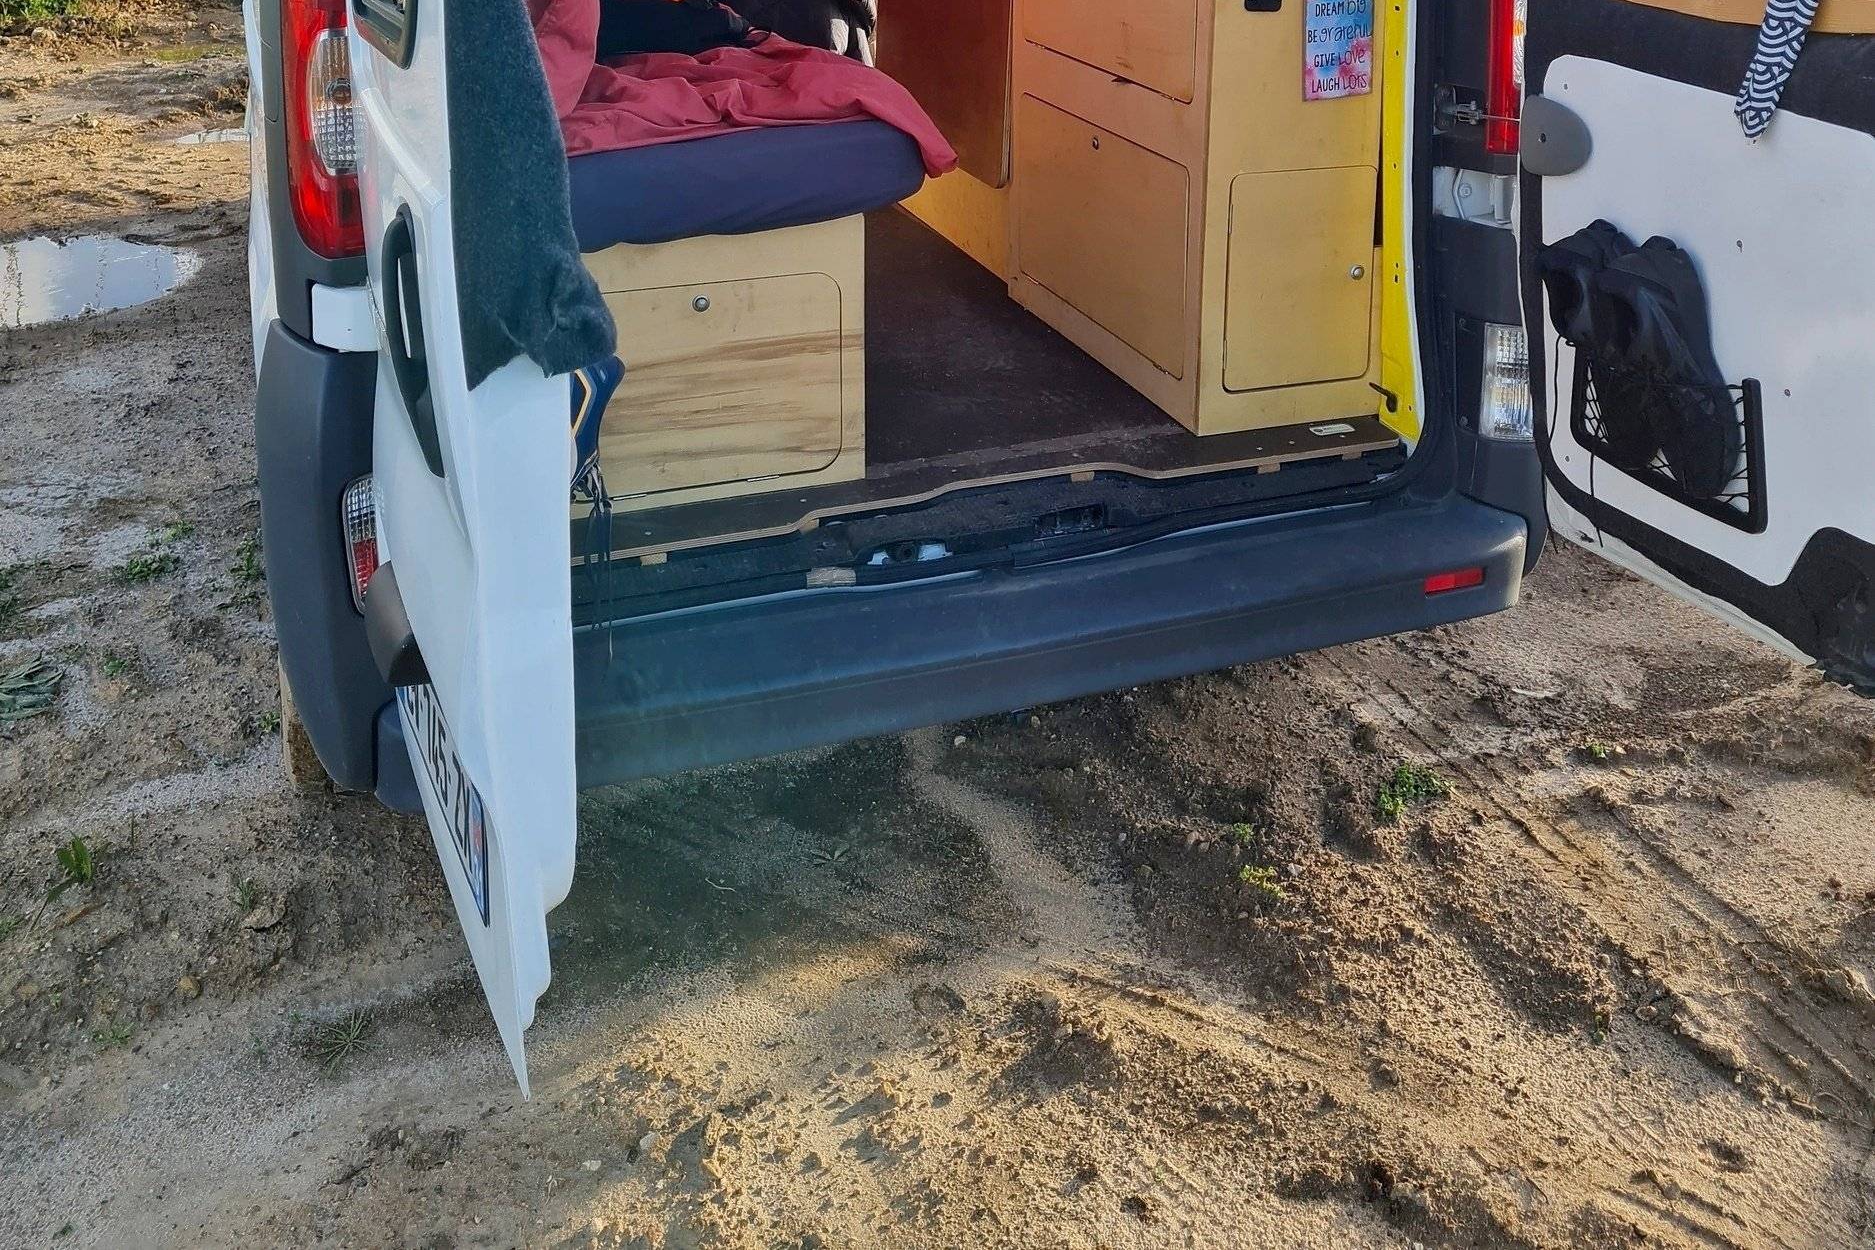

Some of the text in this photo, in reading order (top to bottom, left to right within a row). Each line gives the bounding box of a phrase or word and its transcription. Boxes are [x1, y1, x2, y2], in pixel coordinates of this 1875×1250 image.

[1315, 1, 1344, 17] DREAM
[1307, 29, 1318, 43] BE
[1314, 53, 1335, 67] GIVE
[1312, 77, 1340, 93] LAUGH
